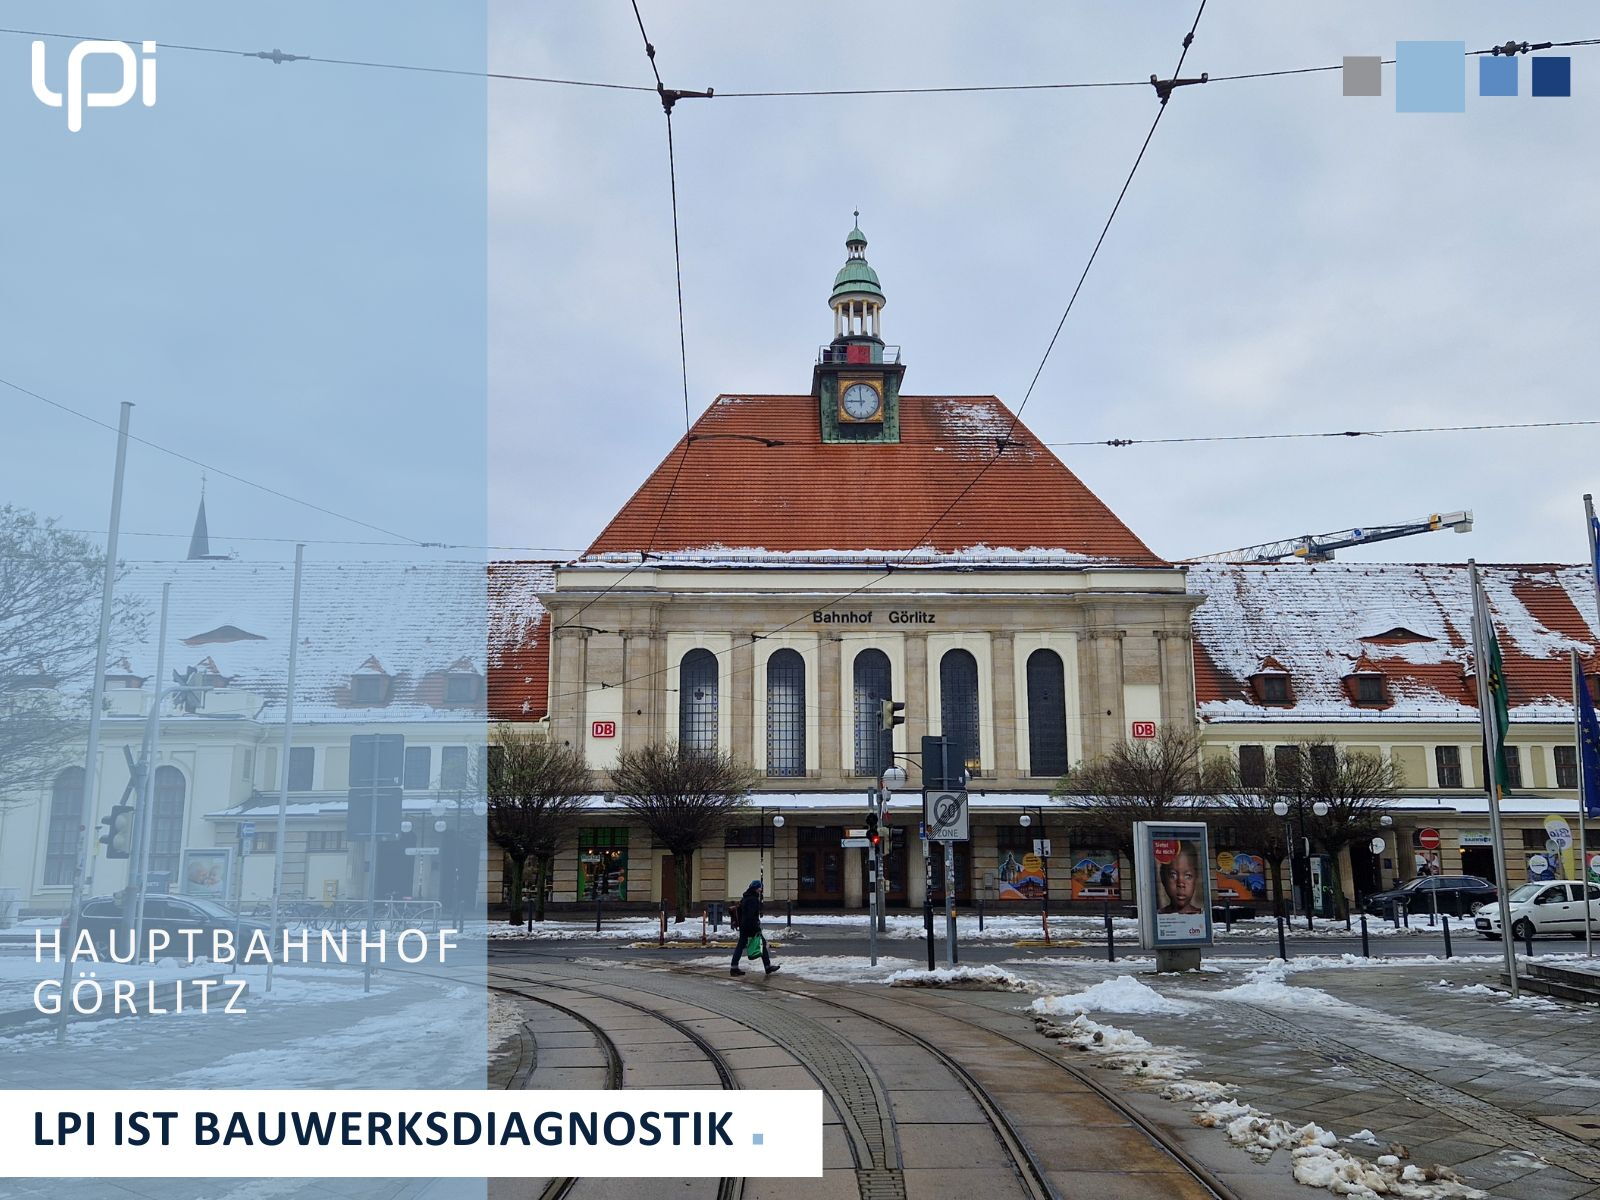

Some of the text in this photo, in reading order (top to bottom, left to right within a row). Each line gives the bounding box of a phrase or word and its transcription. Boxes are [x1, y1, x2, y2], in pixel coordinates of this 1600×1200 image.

[813, 611, 936, 623] Bahnhof Görlitz
[594, 723, 614, 736] DB
[1134, 723, 1154, 736] DB
[940, 803, 957, 818] 20
[938, 829, 959, 837] ZONE
